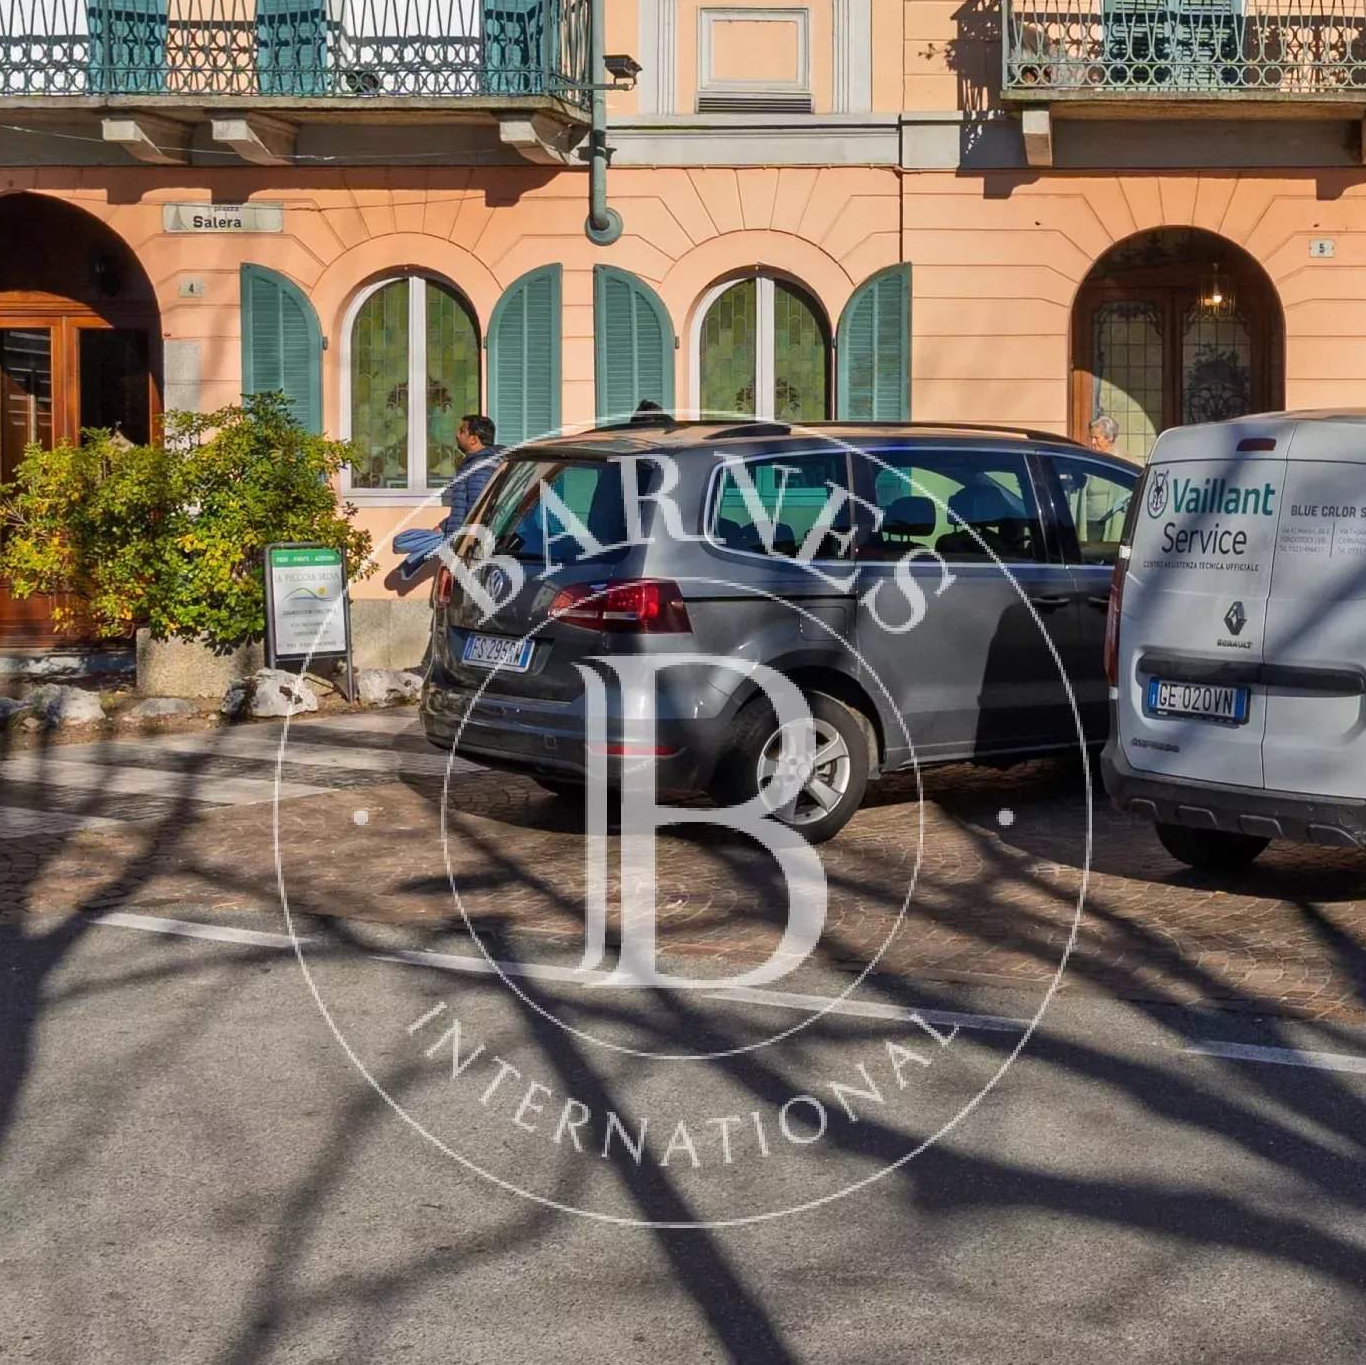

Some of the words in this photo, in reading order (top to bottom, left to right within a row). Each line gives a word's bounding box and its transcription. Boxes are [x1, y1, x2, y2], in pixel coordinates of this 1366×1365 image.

[193, 215, 242, 228] Salera
[1319, 243, 1325, 254] 5
[1173, 478, 1276, 516] Vaillant
[1291, 505, 1318, 516] BLUE
[1322, 505, 1357, 518] CALOR
[1161, 521, 1247, 555] Service
[1198, 561, 1225, 570] TECNICA
[1226, 562, 1260, 572] UFFICIALE
[1159, 684, 1177, 707] GE
[1182, 686, 1233, 715] 020VN
